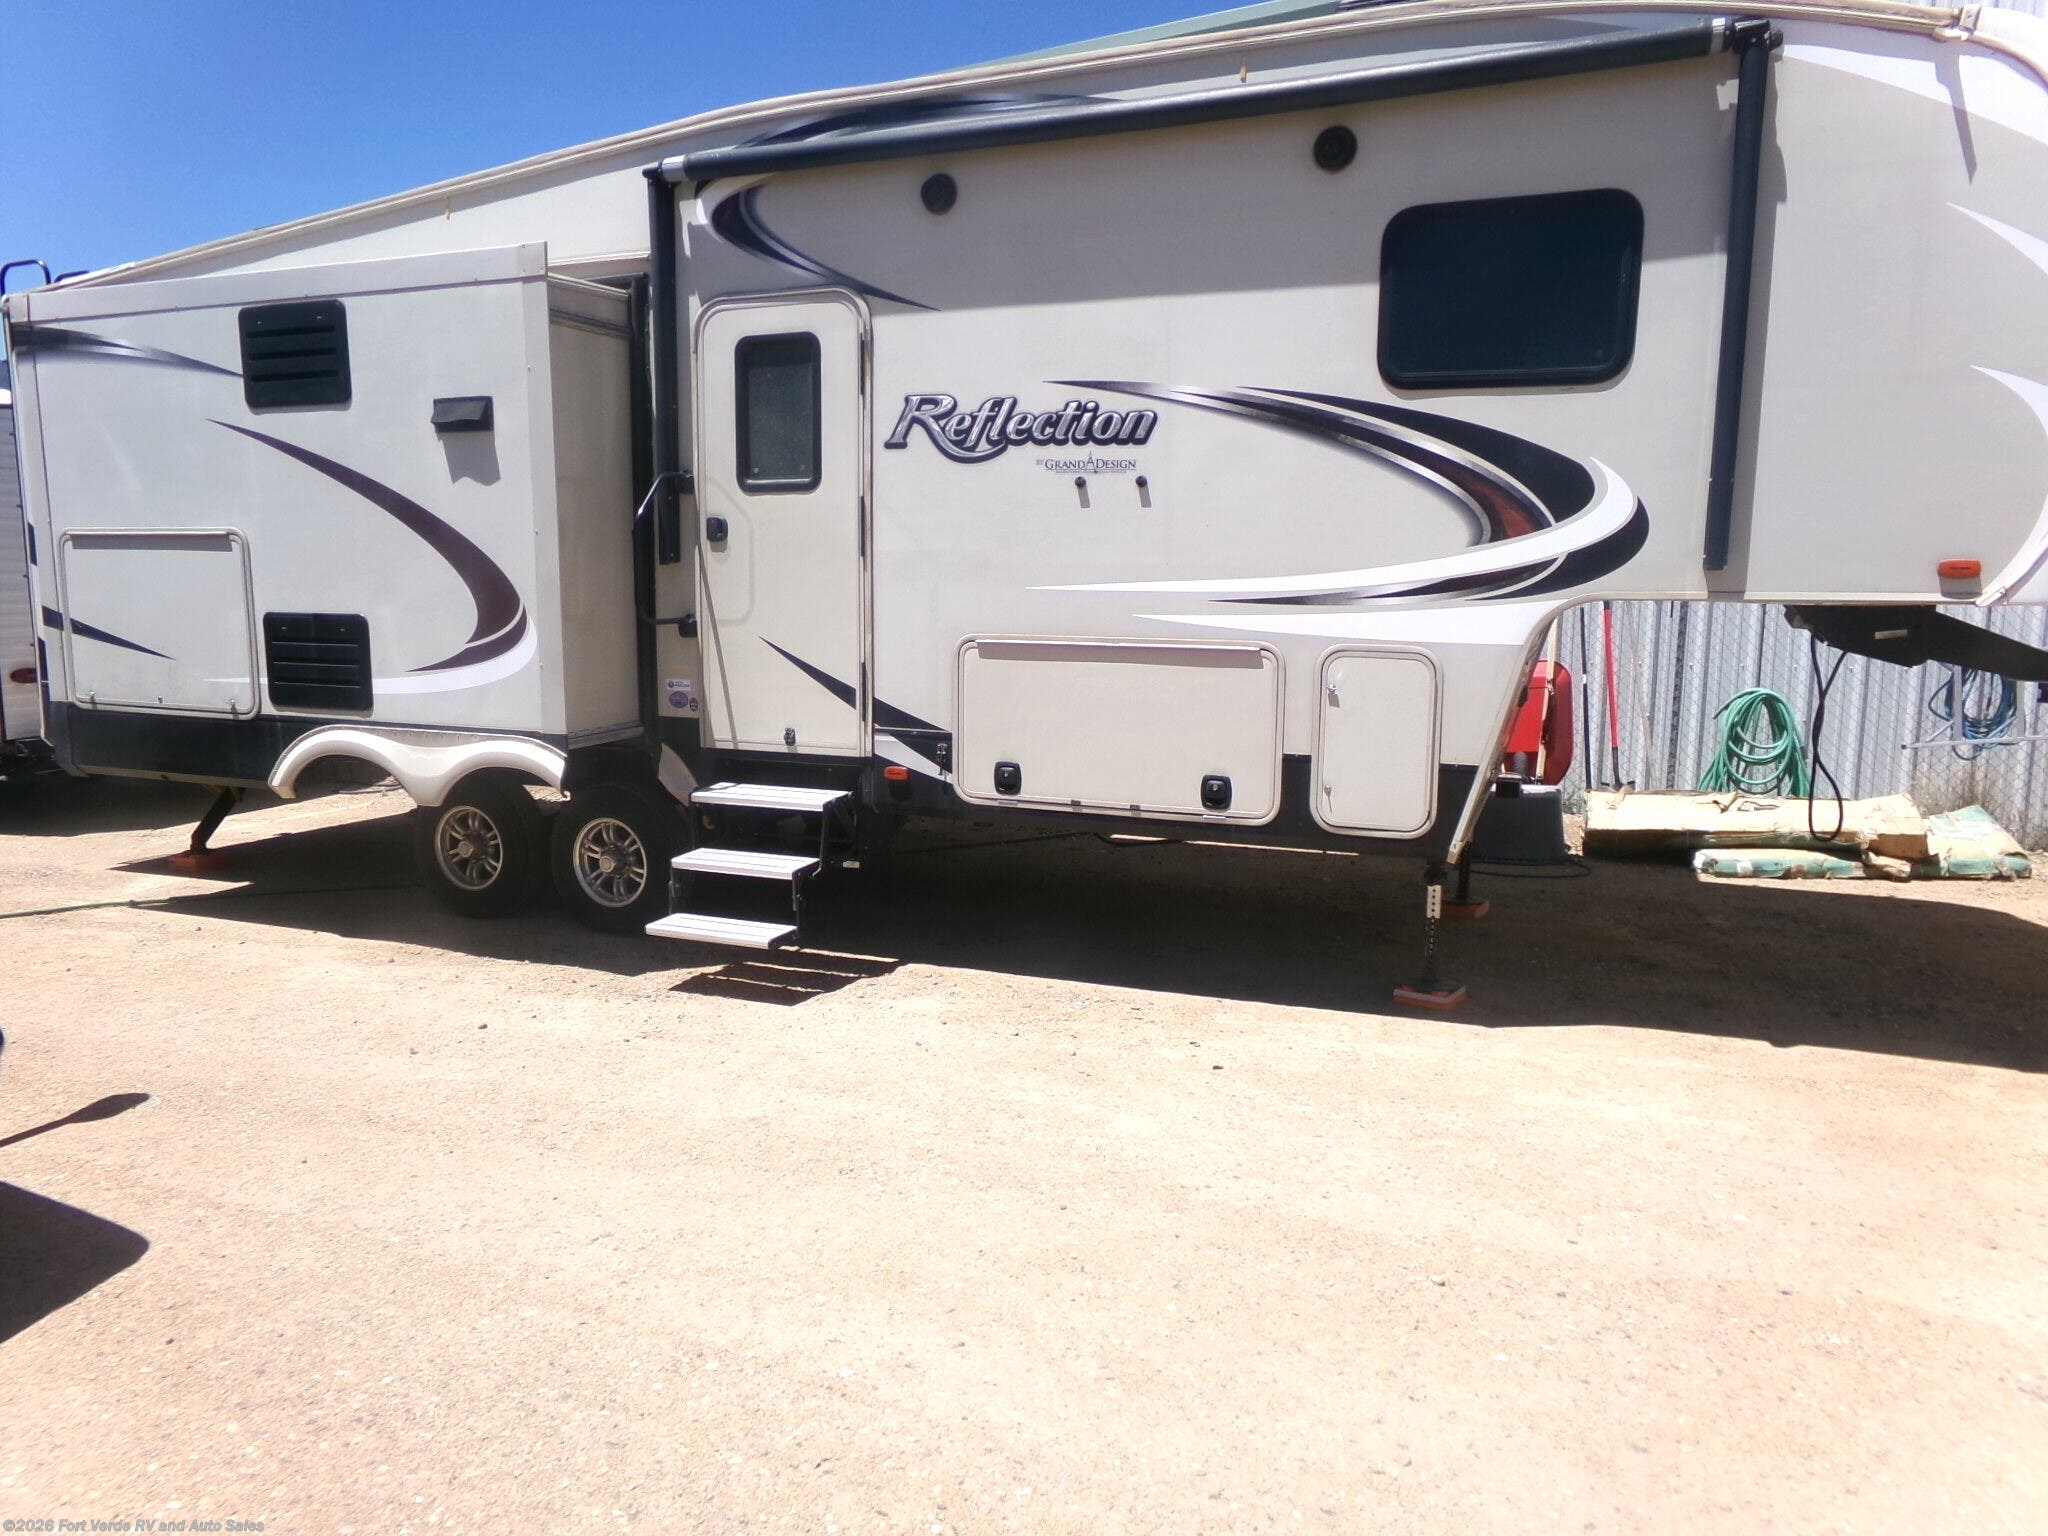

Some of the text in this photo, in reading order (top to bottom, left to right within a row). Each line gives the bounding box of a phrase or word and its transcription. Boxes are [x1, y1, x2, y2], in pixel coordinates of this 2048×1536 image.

[884, 394, 1158, 464] Reflection
[1045, 458, 1086, 470] GRAND
[1096, 458, 1137, 470] DESIGN
